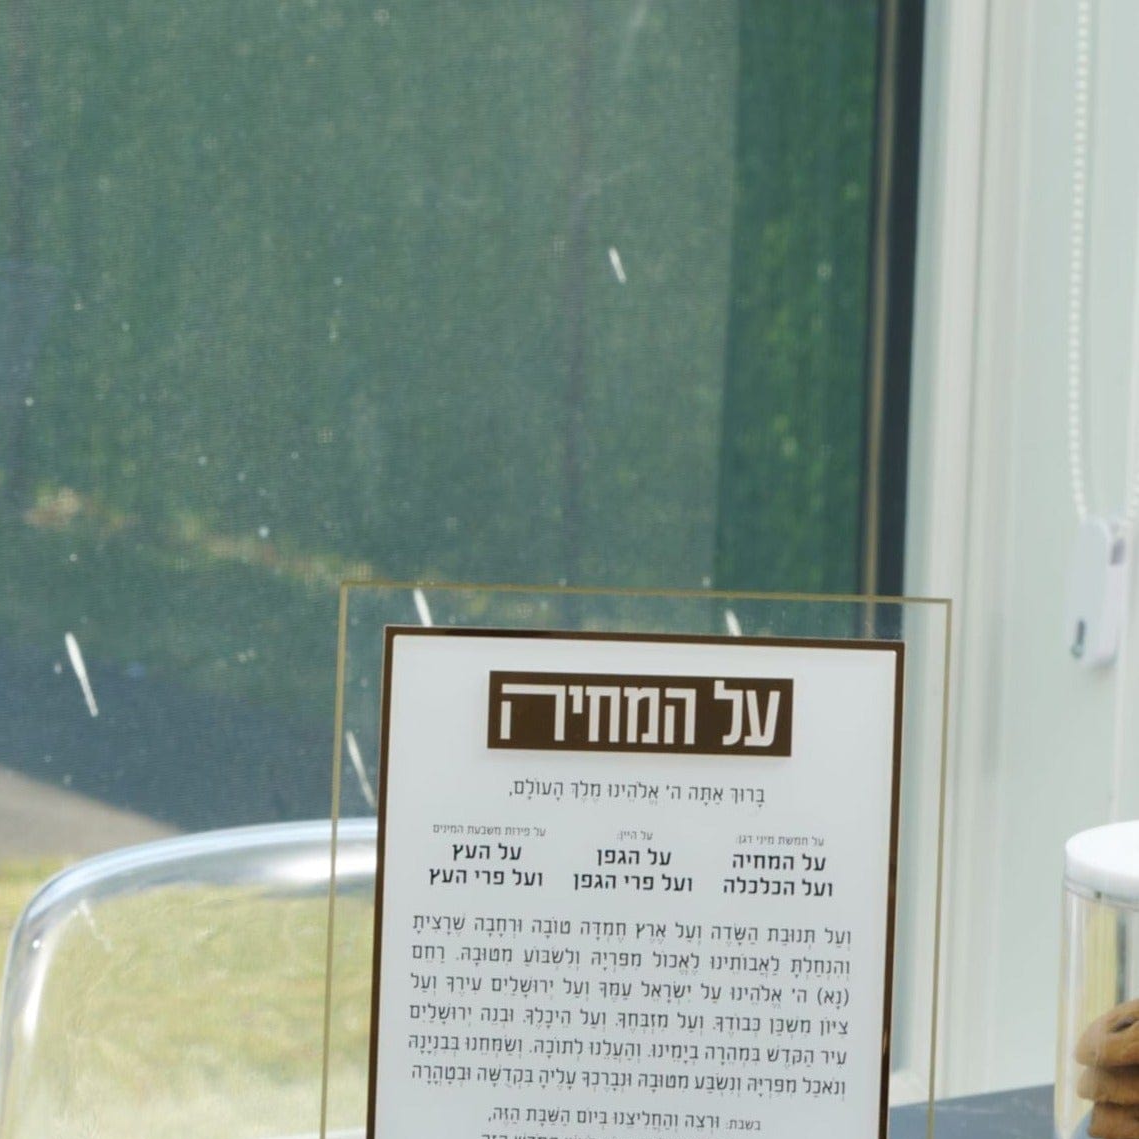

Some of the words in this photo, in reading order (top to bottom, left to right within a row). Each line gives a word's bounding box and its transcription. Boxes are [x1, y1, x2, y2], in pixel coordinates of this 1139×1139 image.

[498, 682, 697, 745] המחיה
[711, 679, 781, 747] על
[450, 843, 491, 863] העץ
[496, 841, 522, 861] על
[595, 848, 640, 868] הגפן
[645, 847, 672, 867] על
[731, 852, 795, 871] המחיה
[800, 852, 827, 872] על
[427, 867, 468, 887] העץ
[473, 869, 505, 886] פרי
[510, 867, 543, 887] ועל
[572, 872, 617, 892] הגפן
[622, 874, 654, 891] פרי
[660, 872, 693, 892] ועל
[722, 875, 795, 896] הכלכלה
[800, 877, 833, 898] ועל
